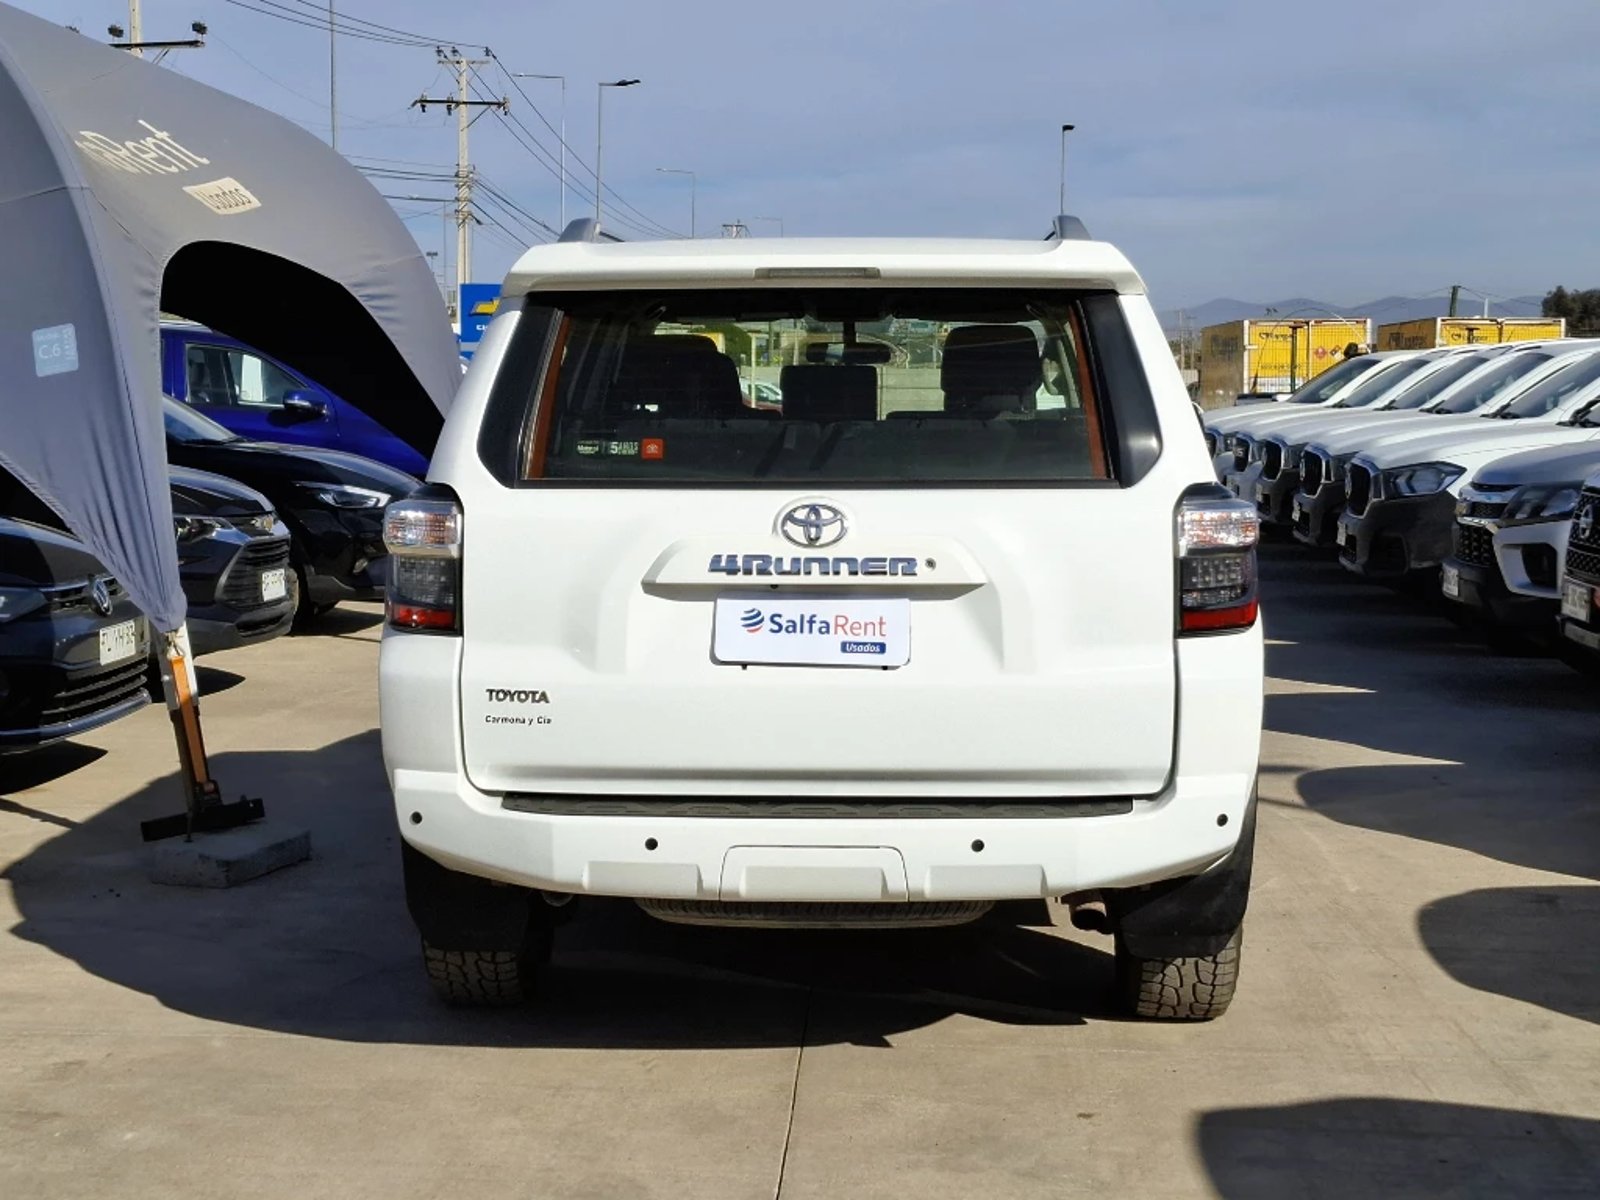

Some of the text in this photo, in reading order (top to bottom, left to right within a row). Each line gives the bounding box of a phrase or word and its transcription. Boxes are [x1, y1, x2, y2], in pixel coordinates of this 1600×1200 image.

[768, 613, 887, 637] SalfaRent
[845, 642, 881, 653] Usados
[485, 688, 550, 703] TOYOTA
[485, 715, 526, 724] Carmona
[528, 718, 533, 726] y
